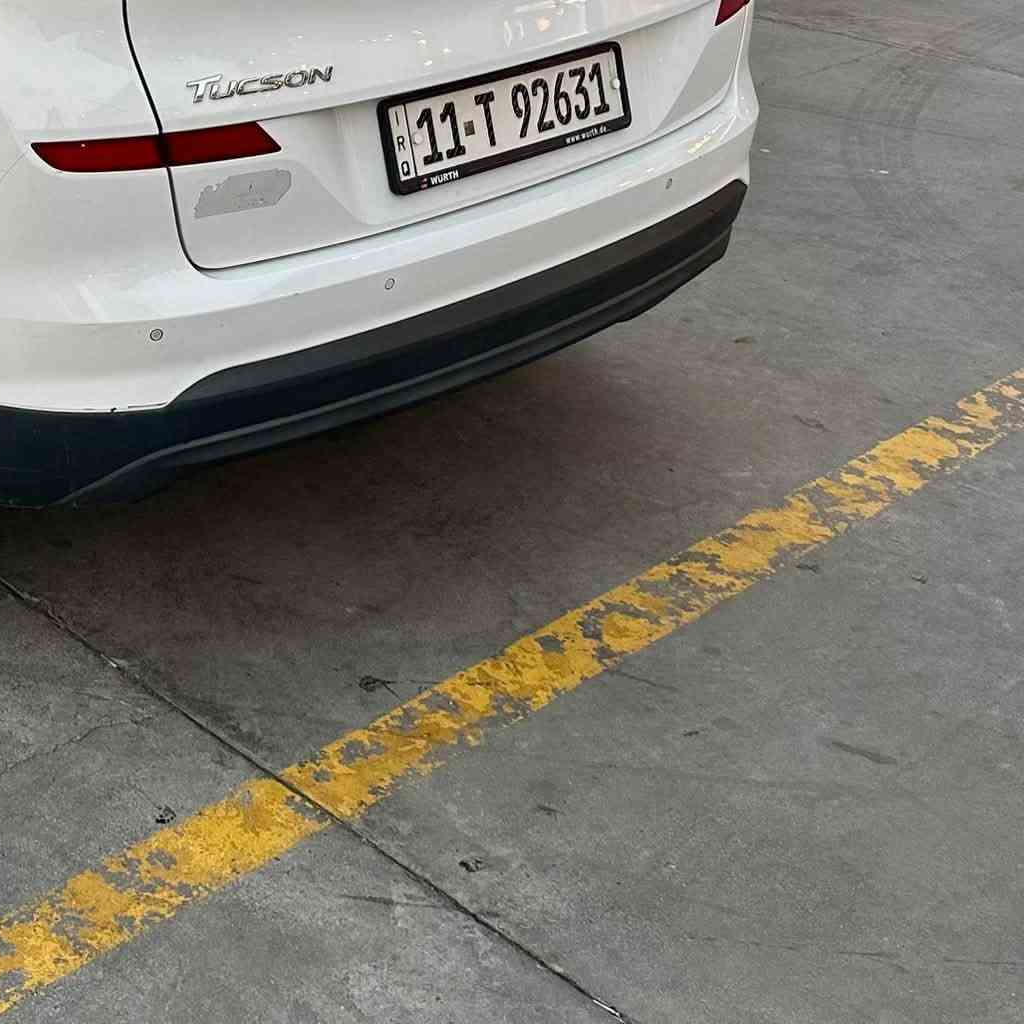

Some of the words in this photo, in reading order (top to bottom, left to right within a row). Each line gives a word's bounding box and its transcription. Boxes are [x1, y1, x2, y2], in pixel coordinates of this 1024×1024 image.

[186, 66, 334, 103] TUCSON
[511, 62, 610, 139] 92631
[430, 169, 459, 185] WURTH
